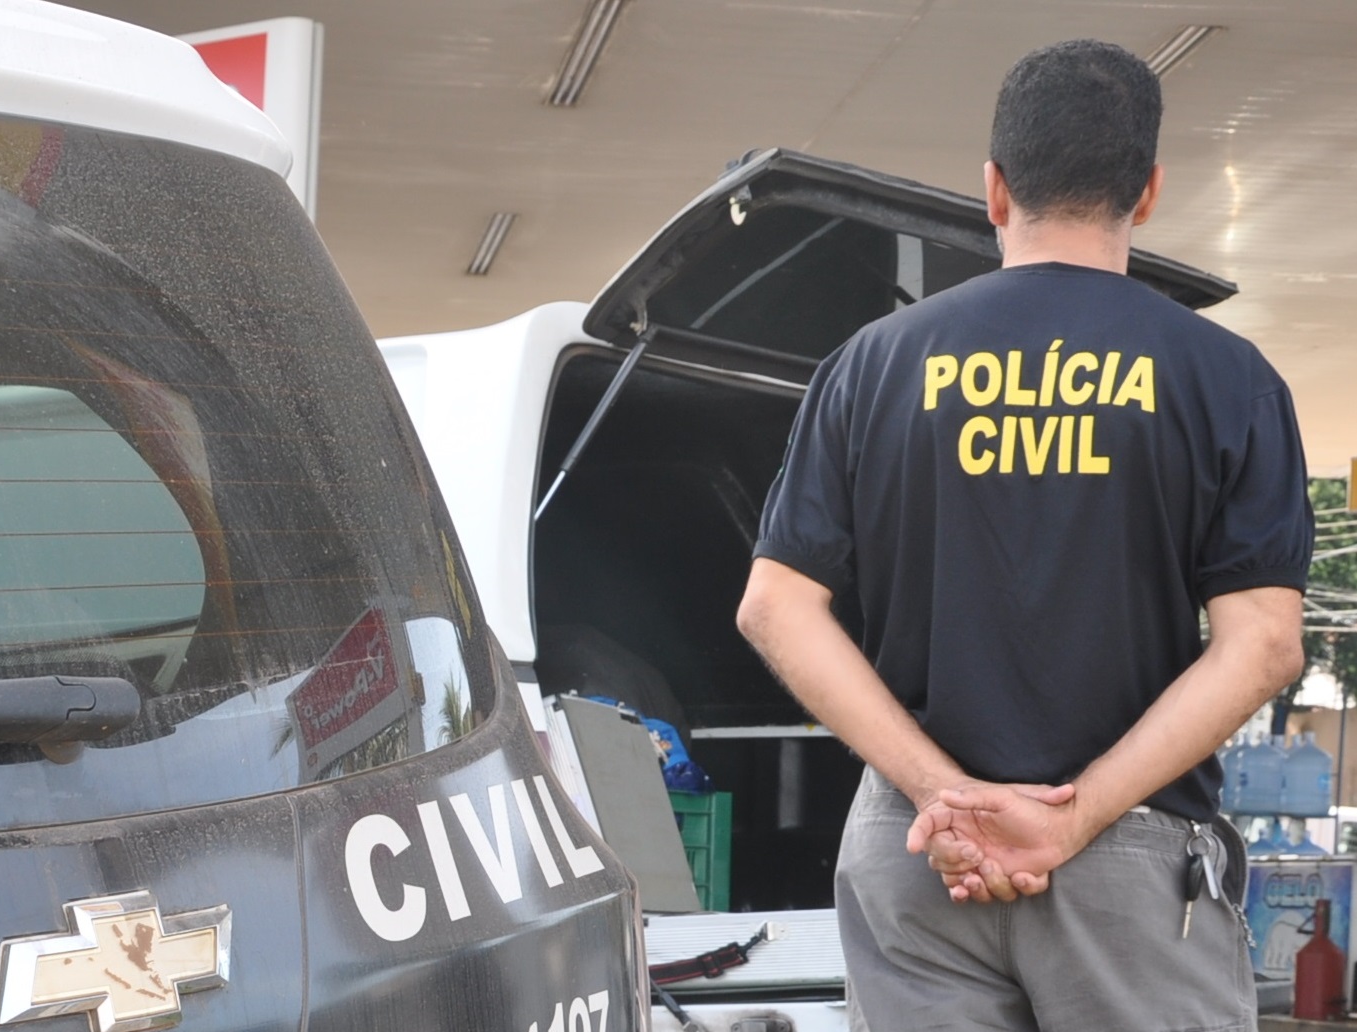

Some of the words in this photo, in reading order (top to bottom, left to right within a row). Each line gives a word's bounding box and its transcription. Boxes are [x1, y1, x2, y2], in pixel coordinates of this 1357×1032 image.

[923, 339, 1155, 413] POLÍCIA
[958, 415, 1110, 475] CIVIL
[344, 775, 605, 942] CIVIL
